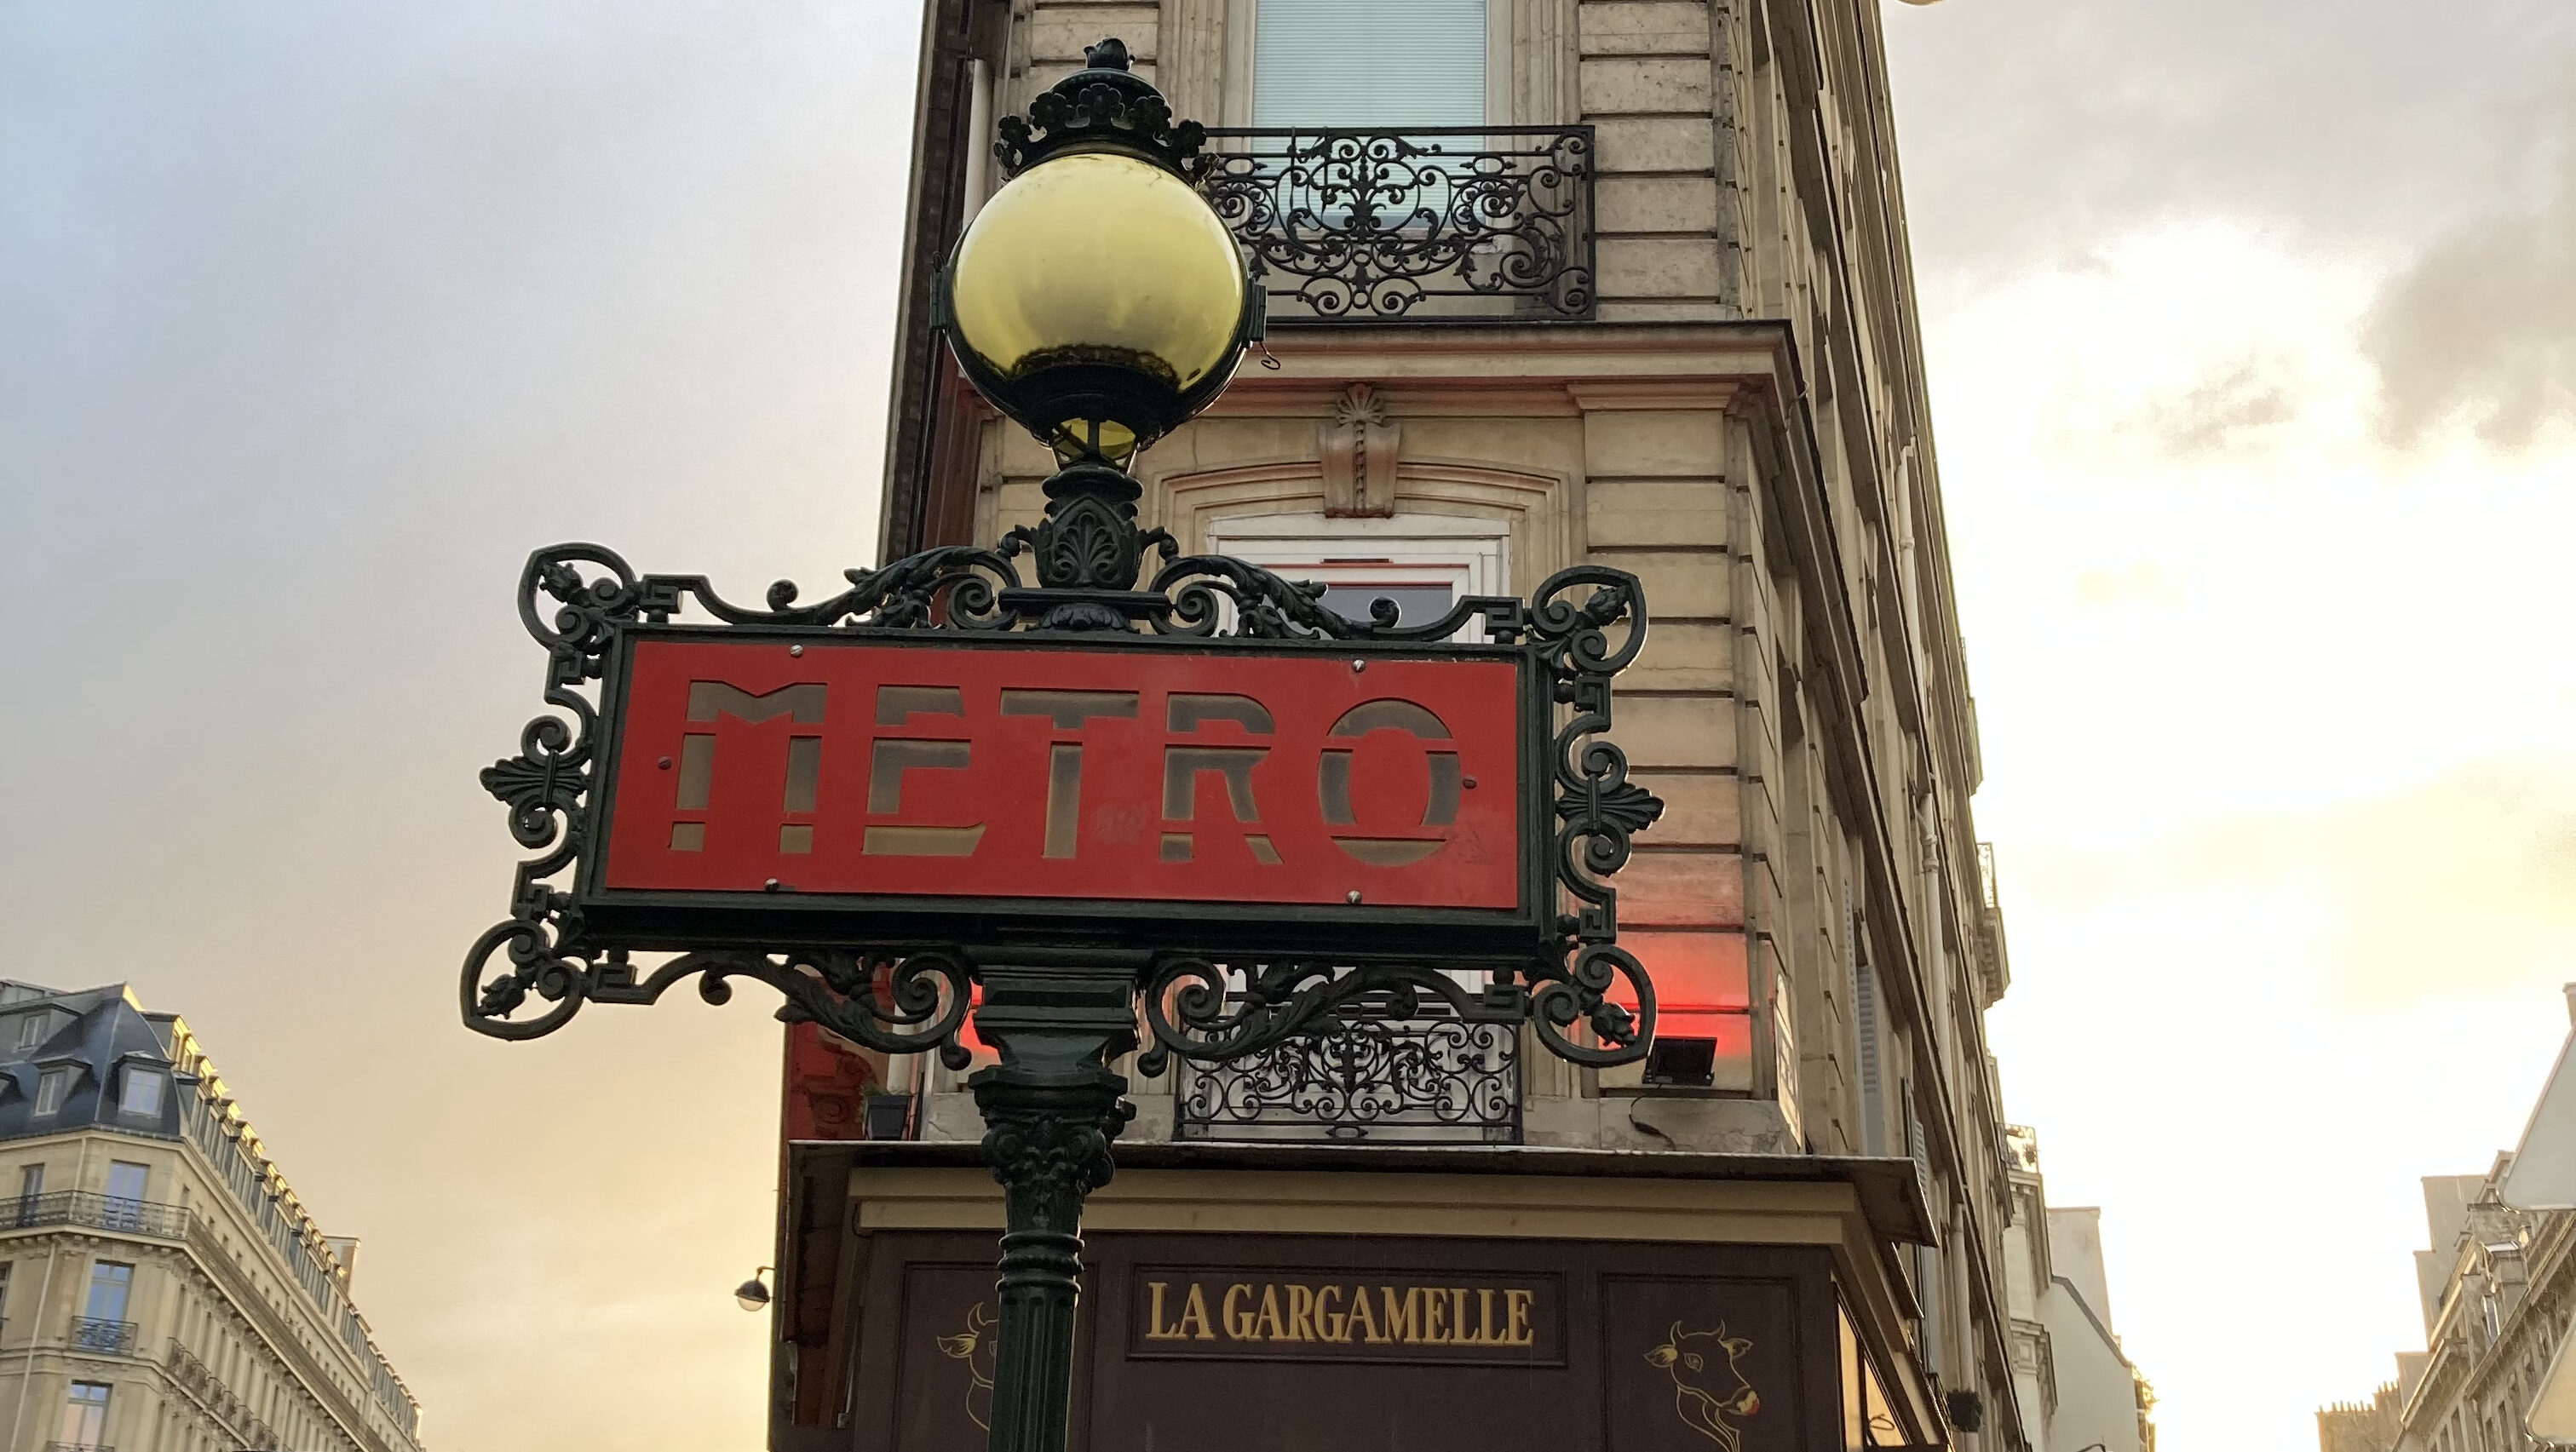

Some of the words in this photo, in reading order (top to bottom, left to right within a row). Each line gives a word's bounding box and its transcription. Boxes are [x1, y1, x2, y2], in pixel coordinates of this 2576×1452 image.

[669, 680, 1461, 867] METRO
[1145, 1281, 1216, 1341] LA
[1222, 1283, 1534, 1347] GARGAMELLE
